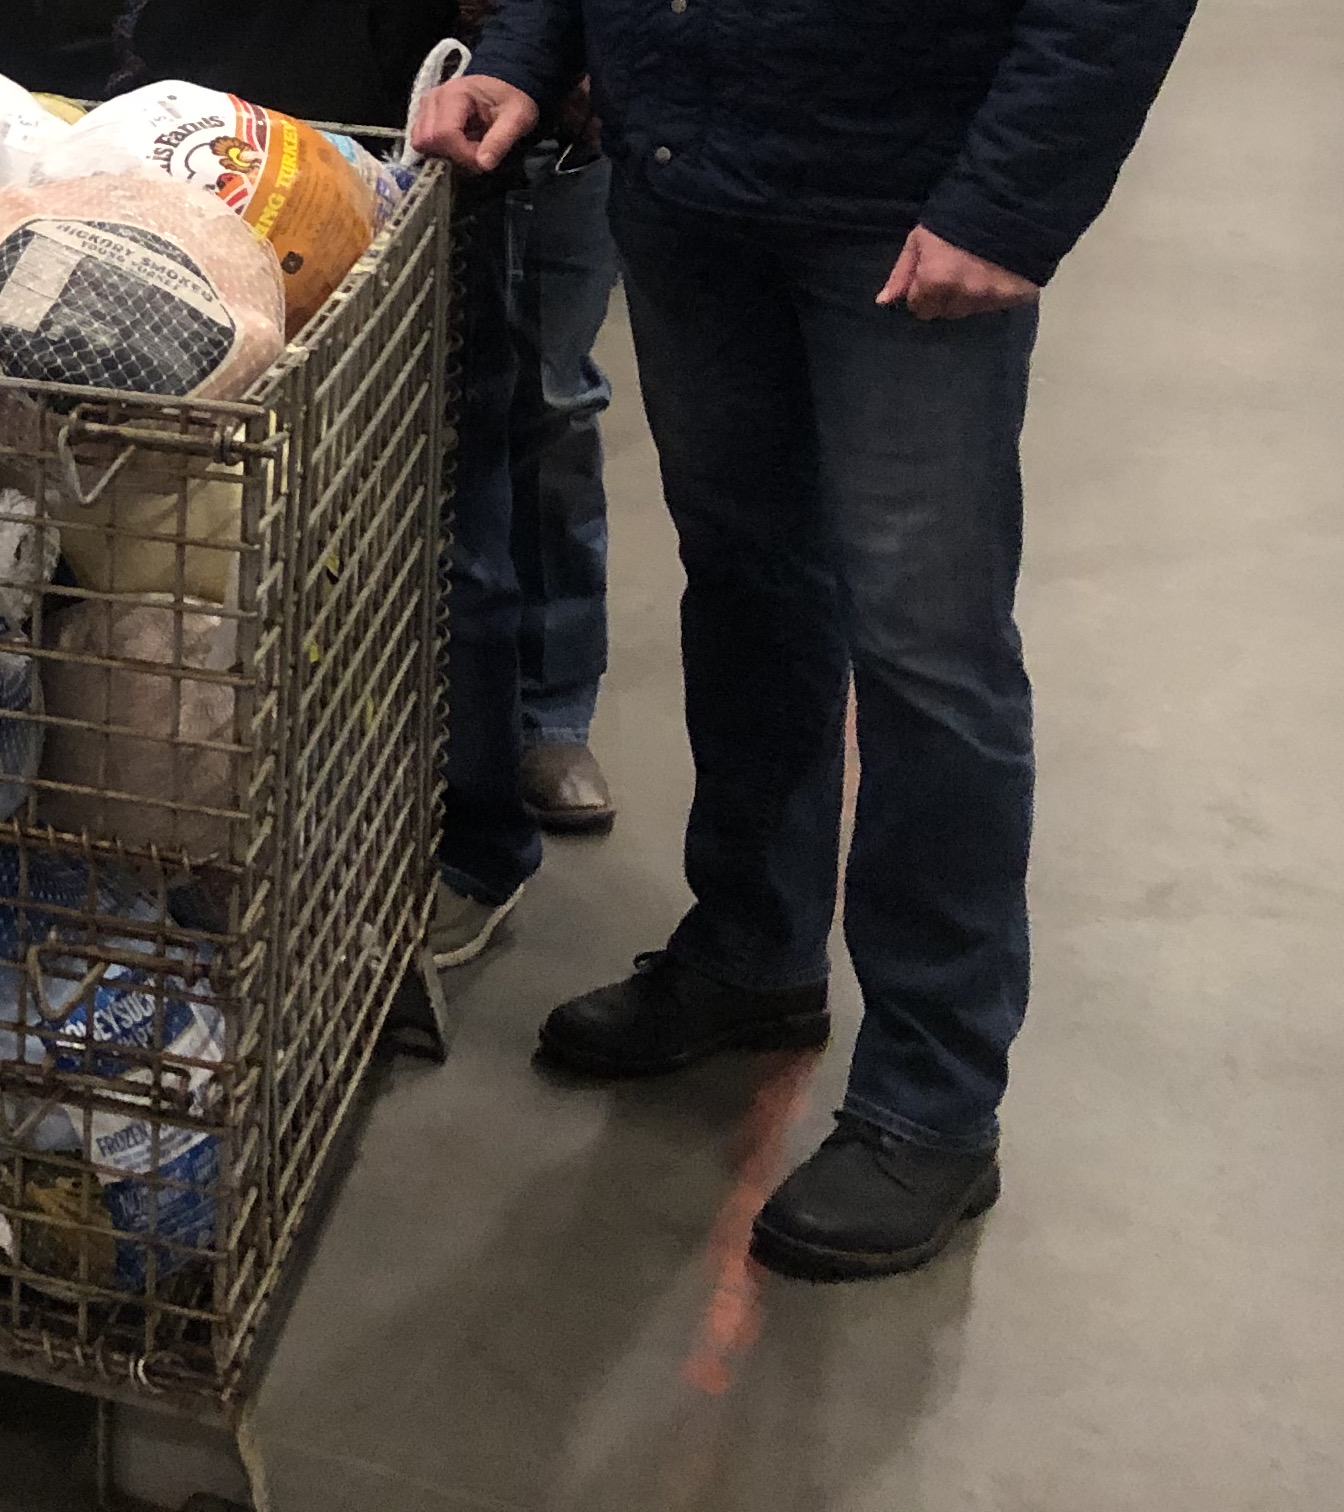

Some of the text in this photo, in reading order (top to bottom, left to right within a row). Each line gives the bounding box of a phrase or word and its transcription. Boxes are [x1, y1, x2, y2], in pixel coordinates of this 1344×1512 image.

[153, 115, 226, 149] Farms
[274, 119, 297, 189] TURKEY
[56, 223, 214, 303] HICKORY SMOKED
[96, 1123, 151, 1158] FROZEN
